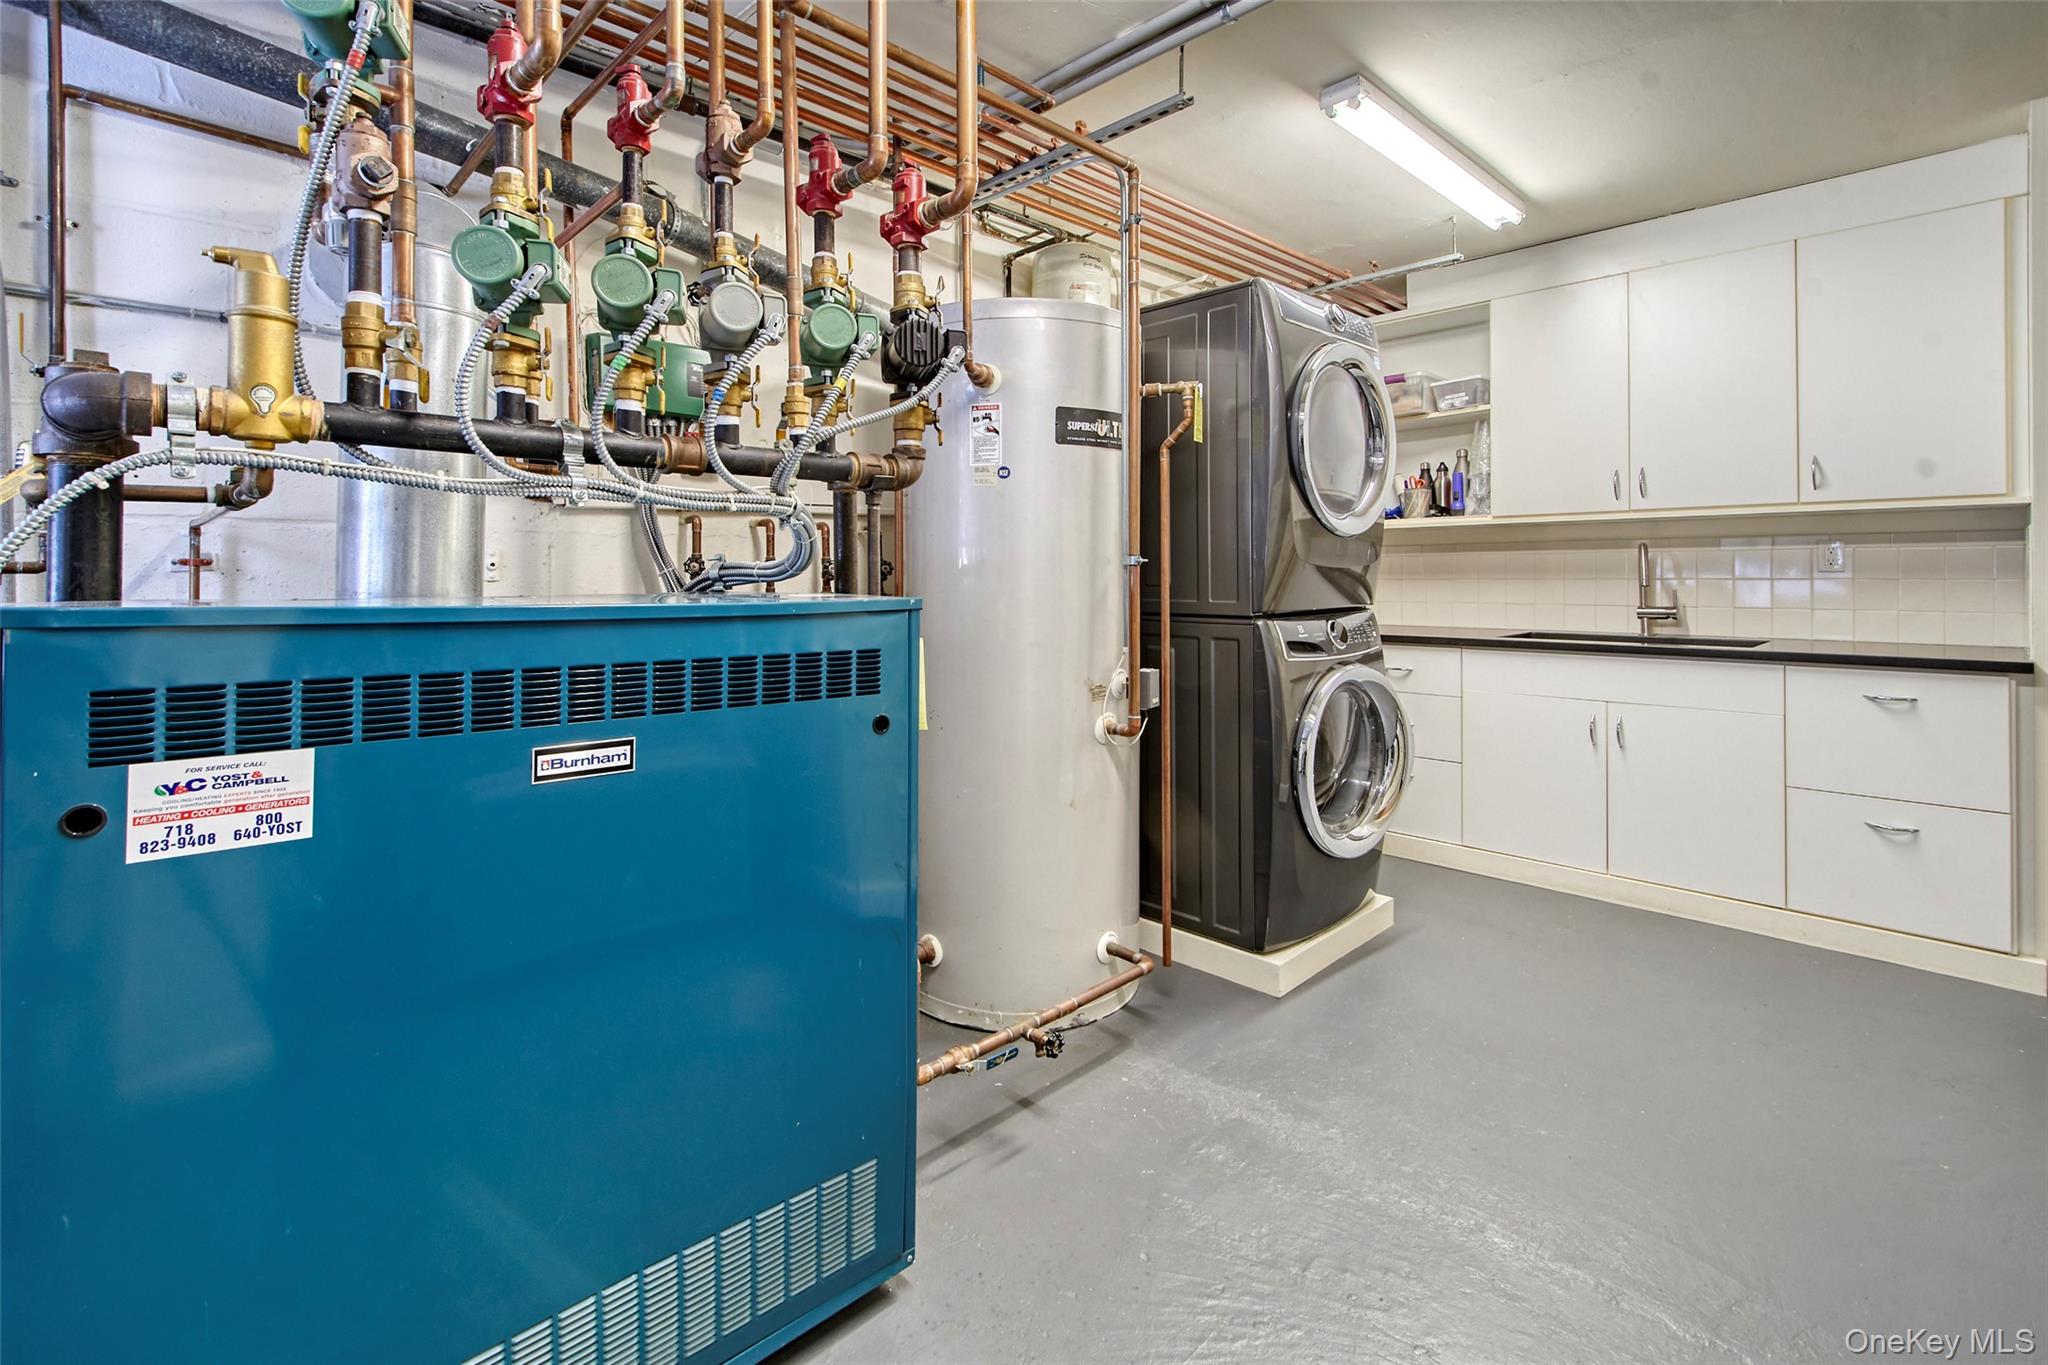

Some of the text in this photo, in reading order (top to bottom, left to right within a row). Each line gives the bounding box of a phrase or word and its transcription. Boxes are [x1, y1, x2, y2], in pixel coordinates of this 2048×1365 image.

[205, 763, 241, 771] SERVICE
[551, 753, 627, 770] Burnham
[212, 770, 263, 782] YOST &
[212, 776, 290, 790] CAMPBELL
[133, 806, 163, 814] Keeping
[165, 804, 179, 812] you
[180, 799, 222, 809] comfortable
[134, 797, 309, 825] HEATING COOLING GENERATORS
[256, 812, 282, 826] 800
[164, 823, 194, 838] 718
[234, 820, 303, 841] 640-YOST
[140, 832, 216, 854] 823-9408
